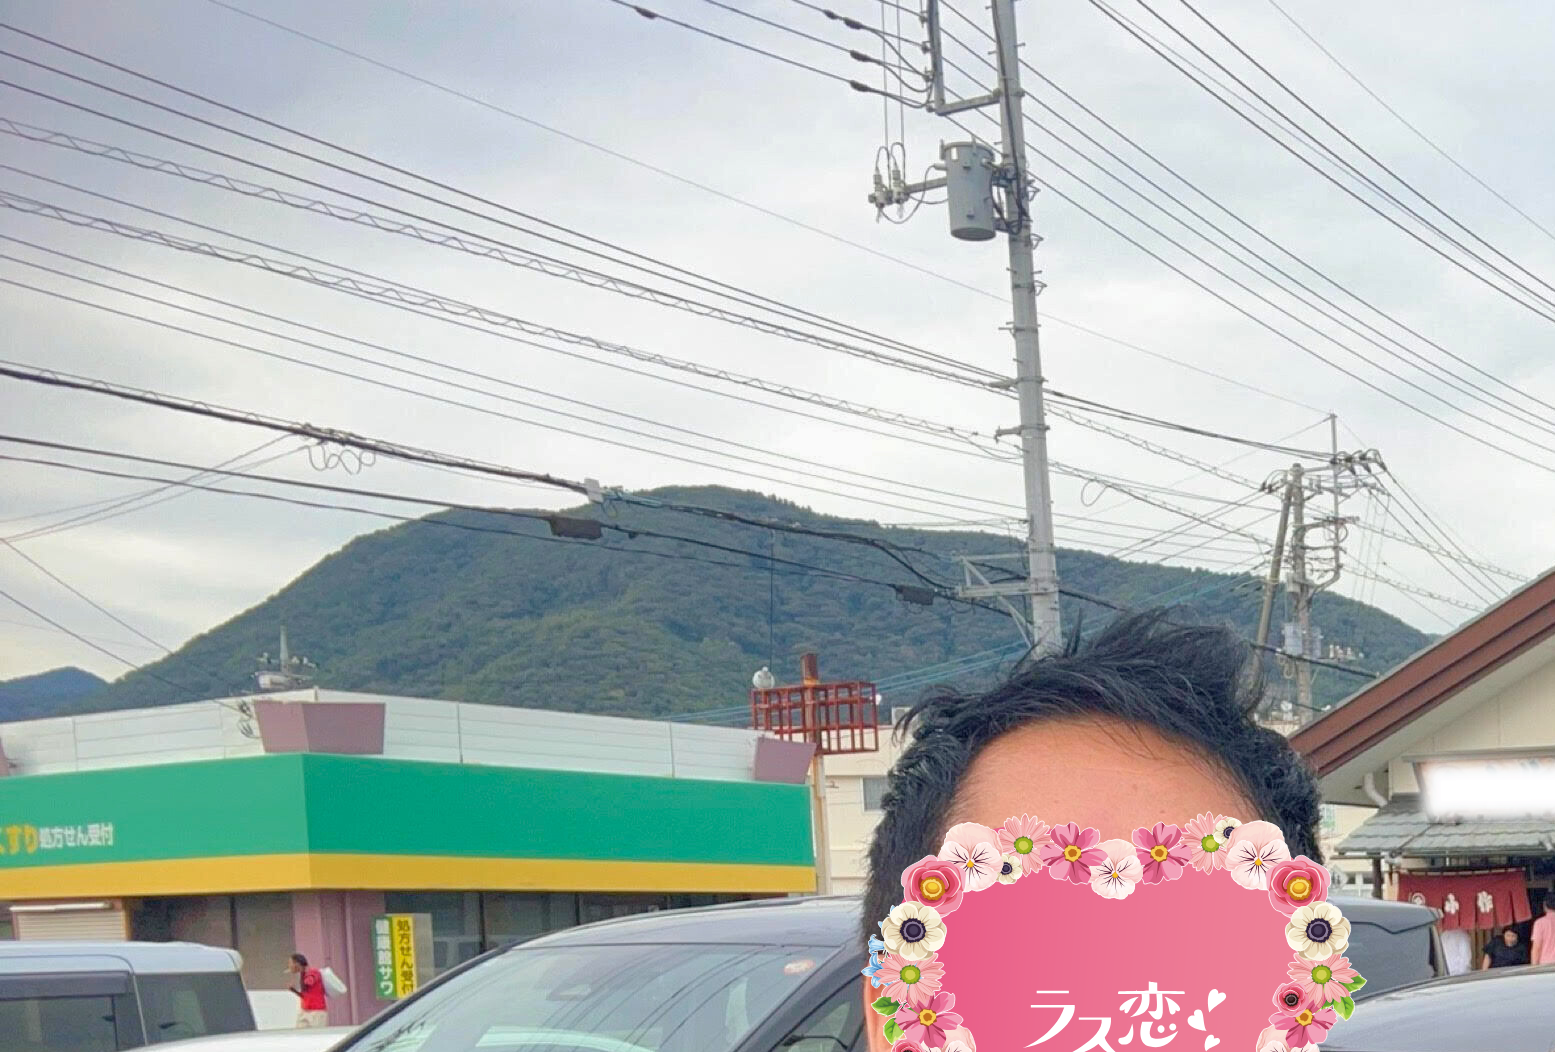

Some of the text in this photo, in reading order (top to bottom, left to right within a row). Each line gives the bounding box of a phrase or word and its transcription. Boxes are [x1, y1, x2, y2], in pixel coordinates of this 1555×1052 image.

[39, 822, 114, 850] 処方せん受付
